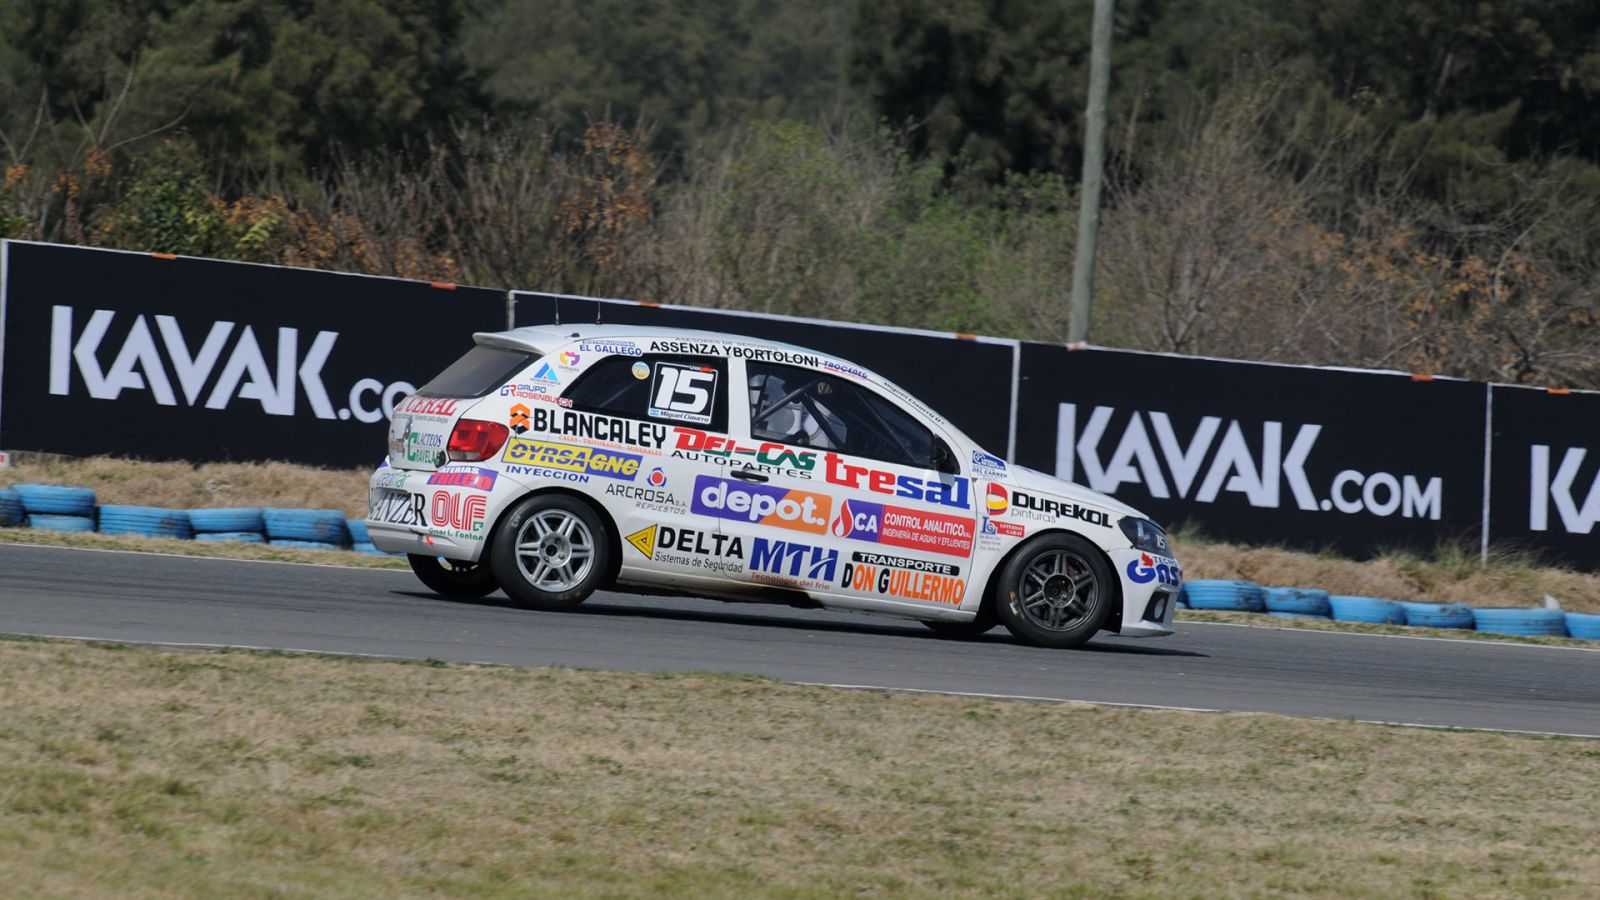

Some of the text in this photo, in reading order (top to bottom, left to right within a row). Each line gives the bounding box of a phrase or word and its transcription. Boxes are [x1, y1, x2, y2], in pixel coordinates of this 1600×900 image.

[594, 345, 642, 356] GALLEGO
[650, 341, 720, 355] ASSENZA
[516, 391, 573, 407] ROSENBUSCH
[517, 384, 547, 394] GRUPO
[654, 366, 714, 414] 15
[534, 408, 666, 449] BLANCALEY
[671, 450, 812, 479] AUTOPARTES
[1055, 402, 1442, 521] KAVAK.COM
[506, 465, 590, 483] INYECCION
[825, 451, 970, 510] tresal
[605, 483, 674, 505] ARCROSA
[701, 482, 825, 526] depot.
[635, 502, 686, 515] REPUESTOS
[1011, 507, 1056, 524] pinturas
[1012, 491, 1113, 528] DUREKOL
[884, 512, 922, 529] CONTROL
[923, 519, 964, 536] ANALITICO
[657, 526, 744, 559] DELTA
[911, 532, 919, 541] DE
[920, 534, 937, 544] AGUAS
[937, 537, 942, 545] Y
[941, 537, 970, 550] EFLUENTES
[1156, 534, 1166, 549] 15
[655, 551, 743, 573] Sistemas de Seguridad
[750, 538, 839, 582] MTH
[859, 553, 951, 574] TRANSPORTE
[800, 579, 813, 587] del
[841, 562, 965, 605] DON GUILLERMO
